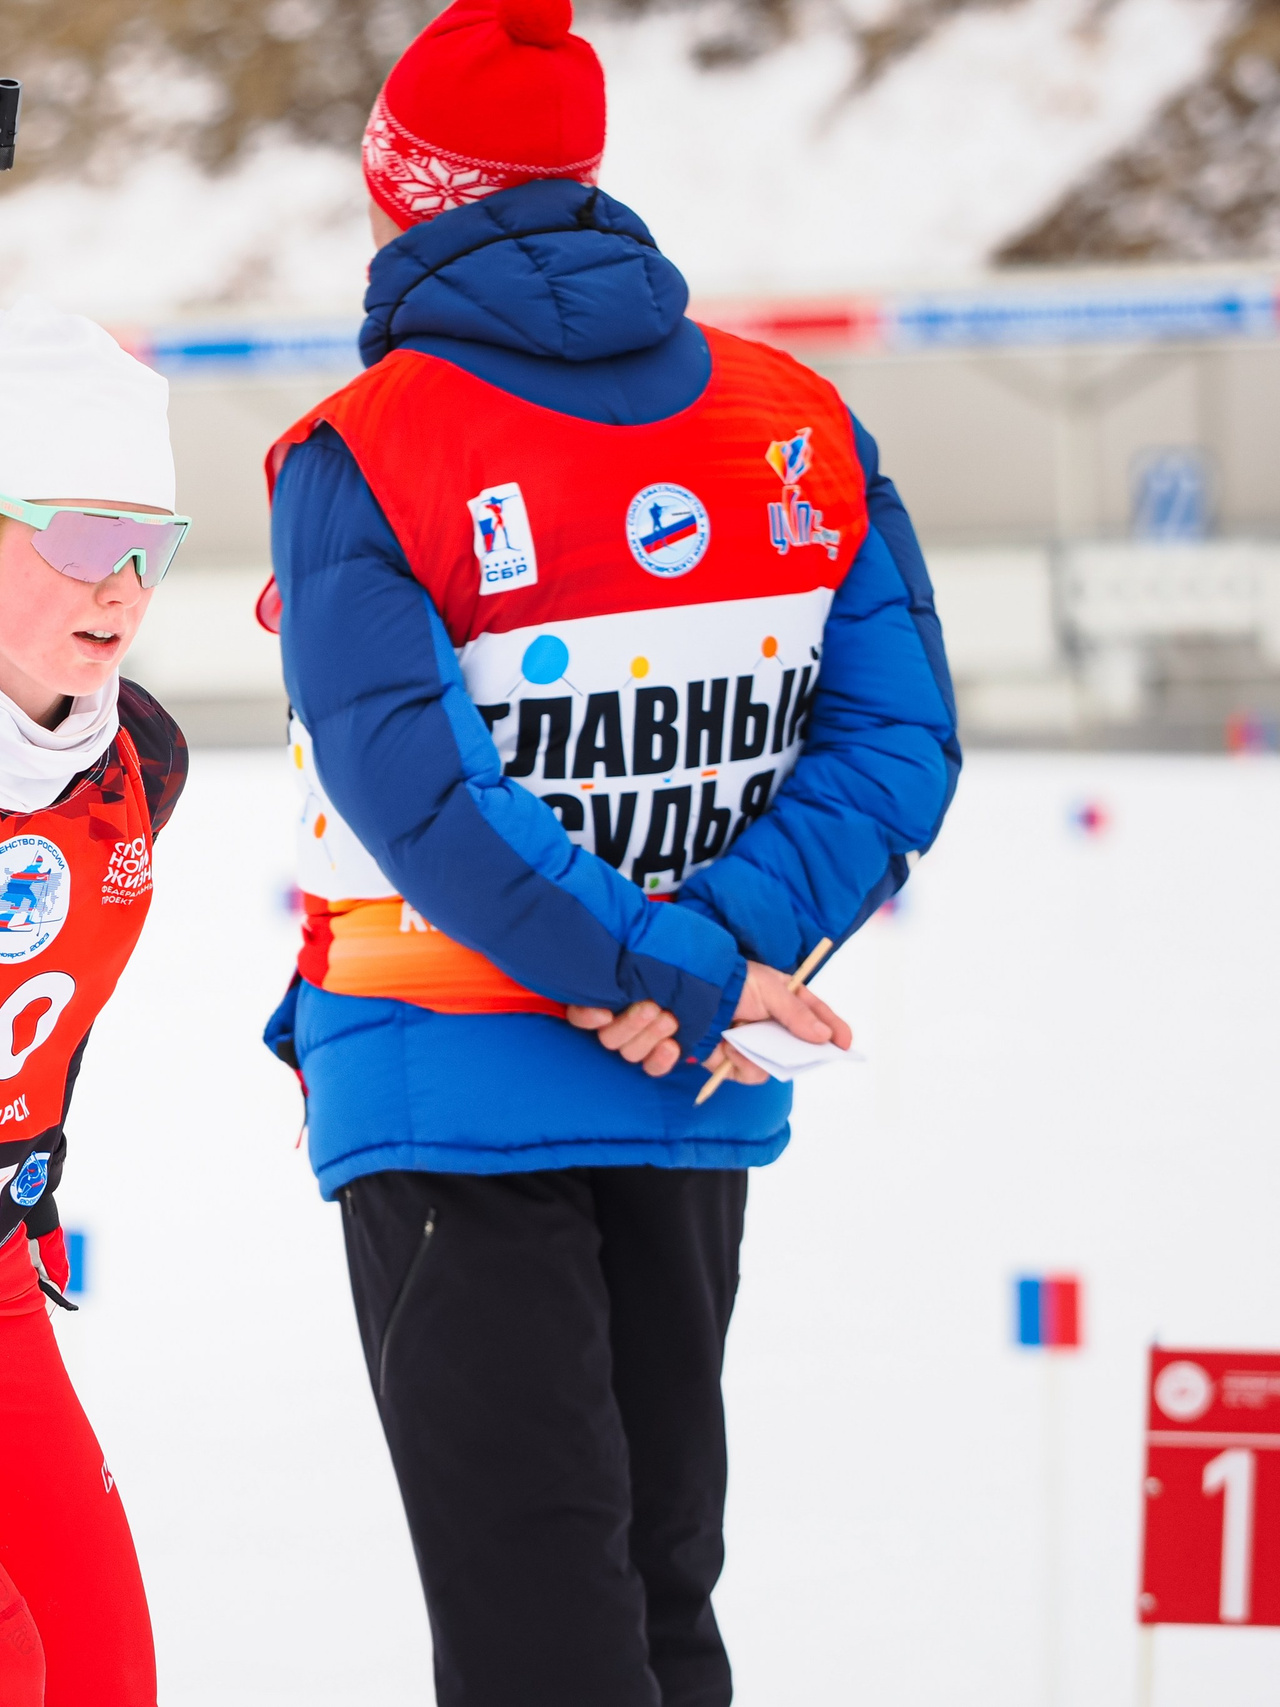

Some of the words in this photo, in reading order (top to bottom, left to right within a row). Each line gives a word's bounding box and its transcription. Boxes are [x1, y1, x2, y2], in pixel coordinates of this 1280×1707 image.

[485, 563, 528, 583] СБР
[37, 839, 65, 870] РОССИИ
[29, 932, 50, 953] 2023
[1201, 1447, 1256, 1622] 1
